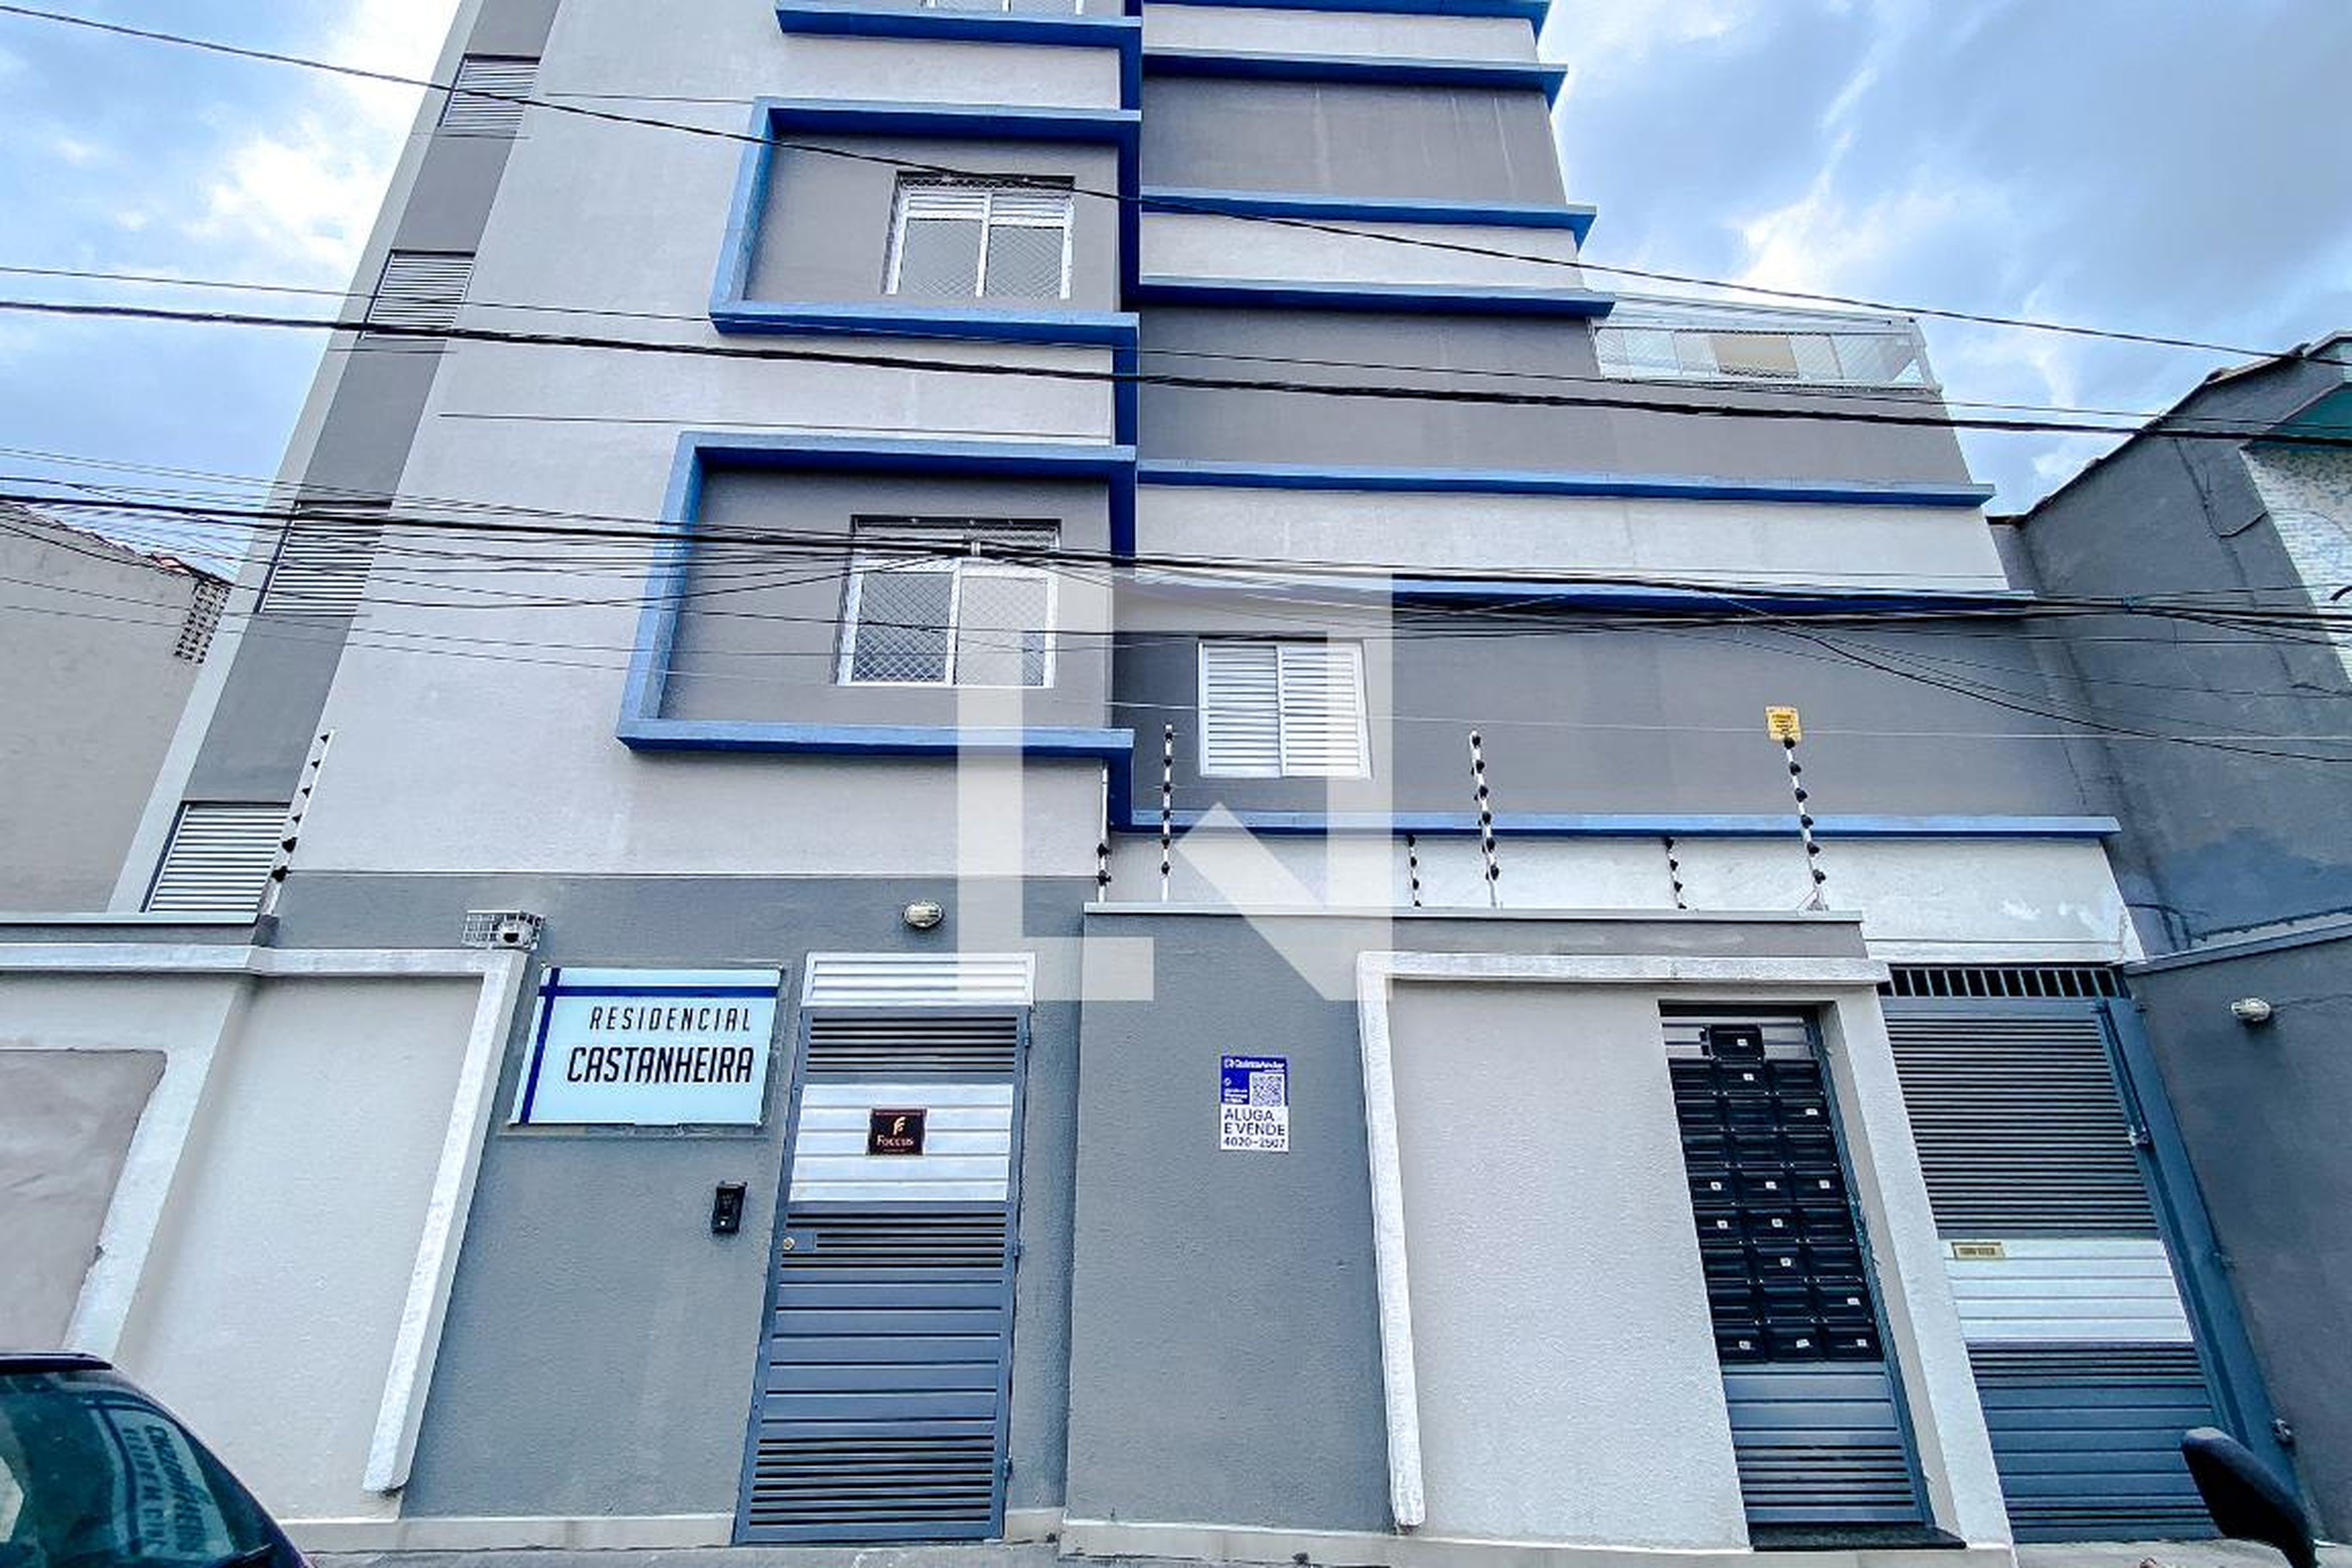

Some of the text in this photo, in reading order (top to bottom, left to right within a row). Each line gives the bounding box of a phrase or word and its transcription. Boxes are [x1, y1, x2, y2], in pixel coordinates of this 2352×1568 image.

[589, 1006, 750, 1031] RESIDENCIAL
[567, 1046, 754, 1083] CASTANHEIRA
[1224, 1108, 1275, 1121] ALUGA
[1224, 1123, 1285, 1136] E VENDE
